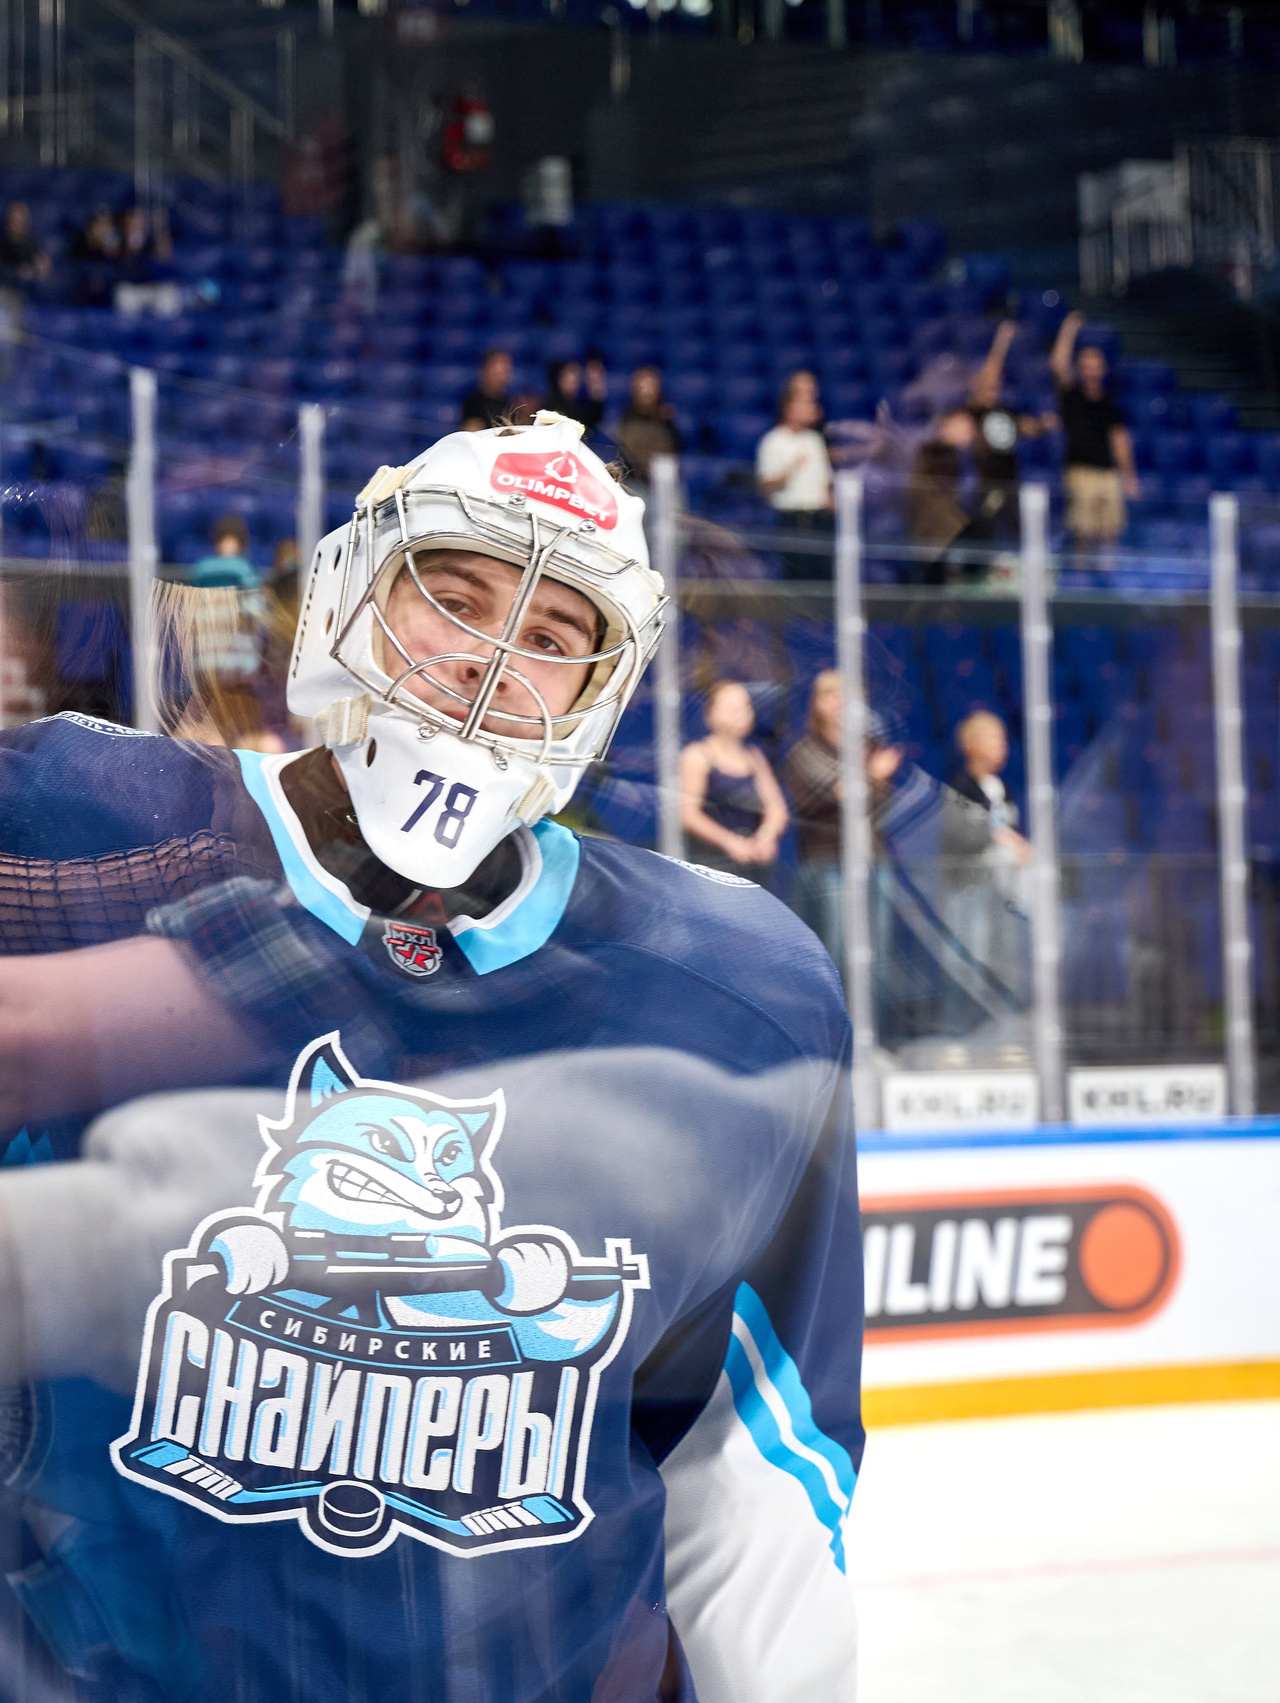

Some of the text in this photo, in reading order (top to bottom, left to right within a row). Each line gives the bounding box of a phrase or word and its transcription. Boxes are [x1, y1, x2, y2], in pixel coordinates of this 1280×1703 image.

[496, 474, 611, 522] OLIMPBET
[400, 769, 480, 849] 78
[258, 1309, 492, 1361] СИБИРСКИЕ
